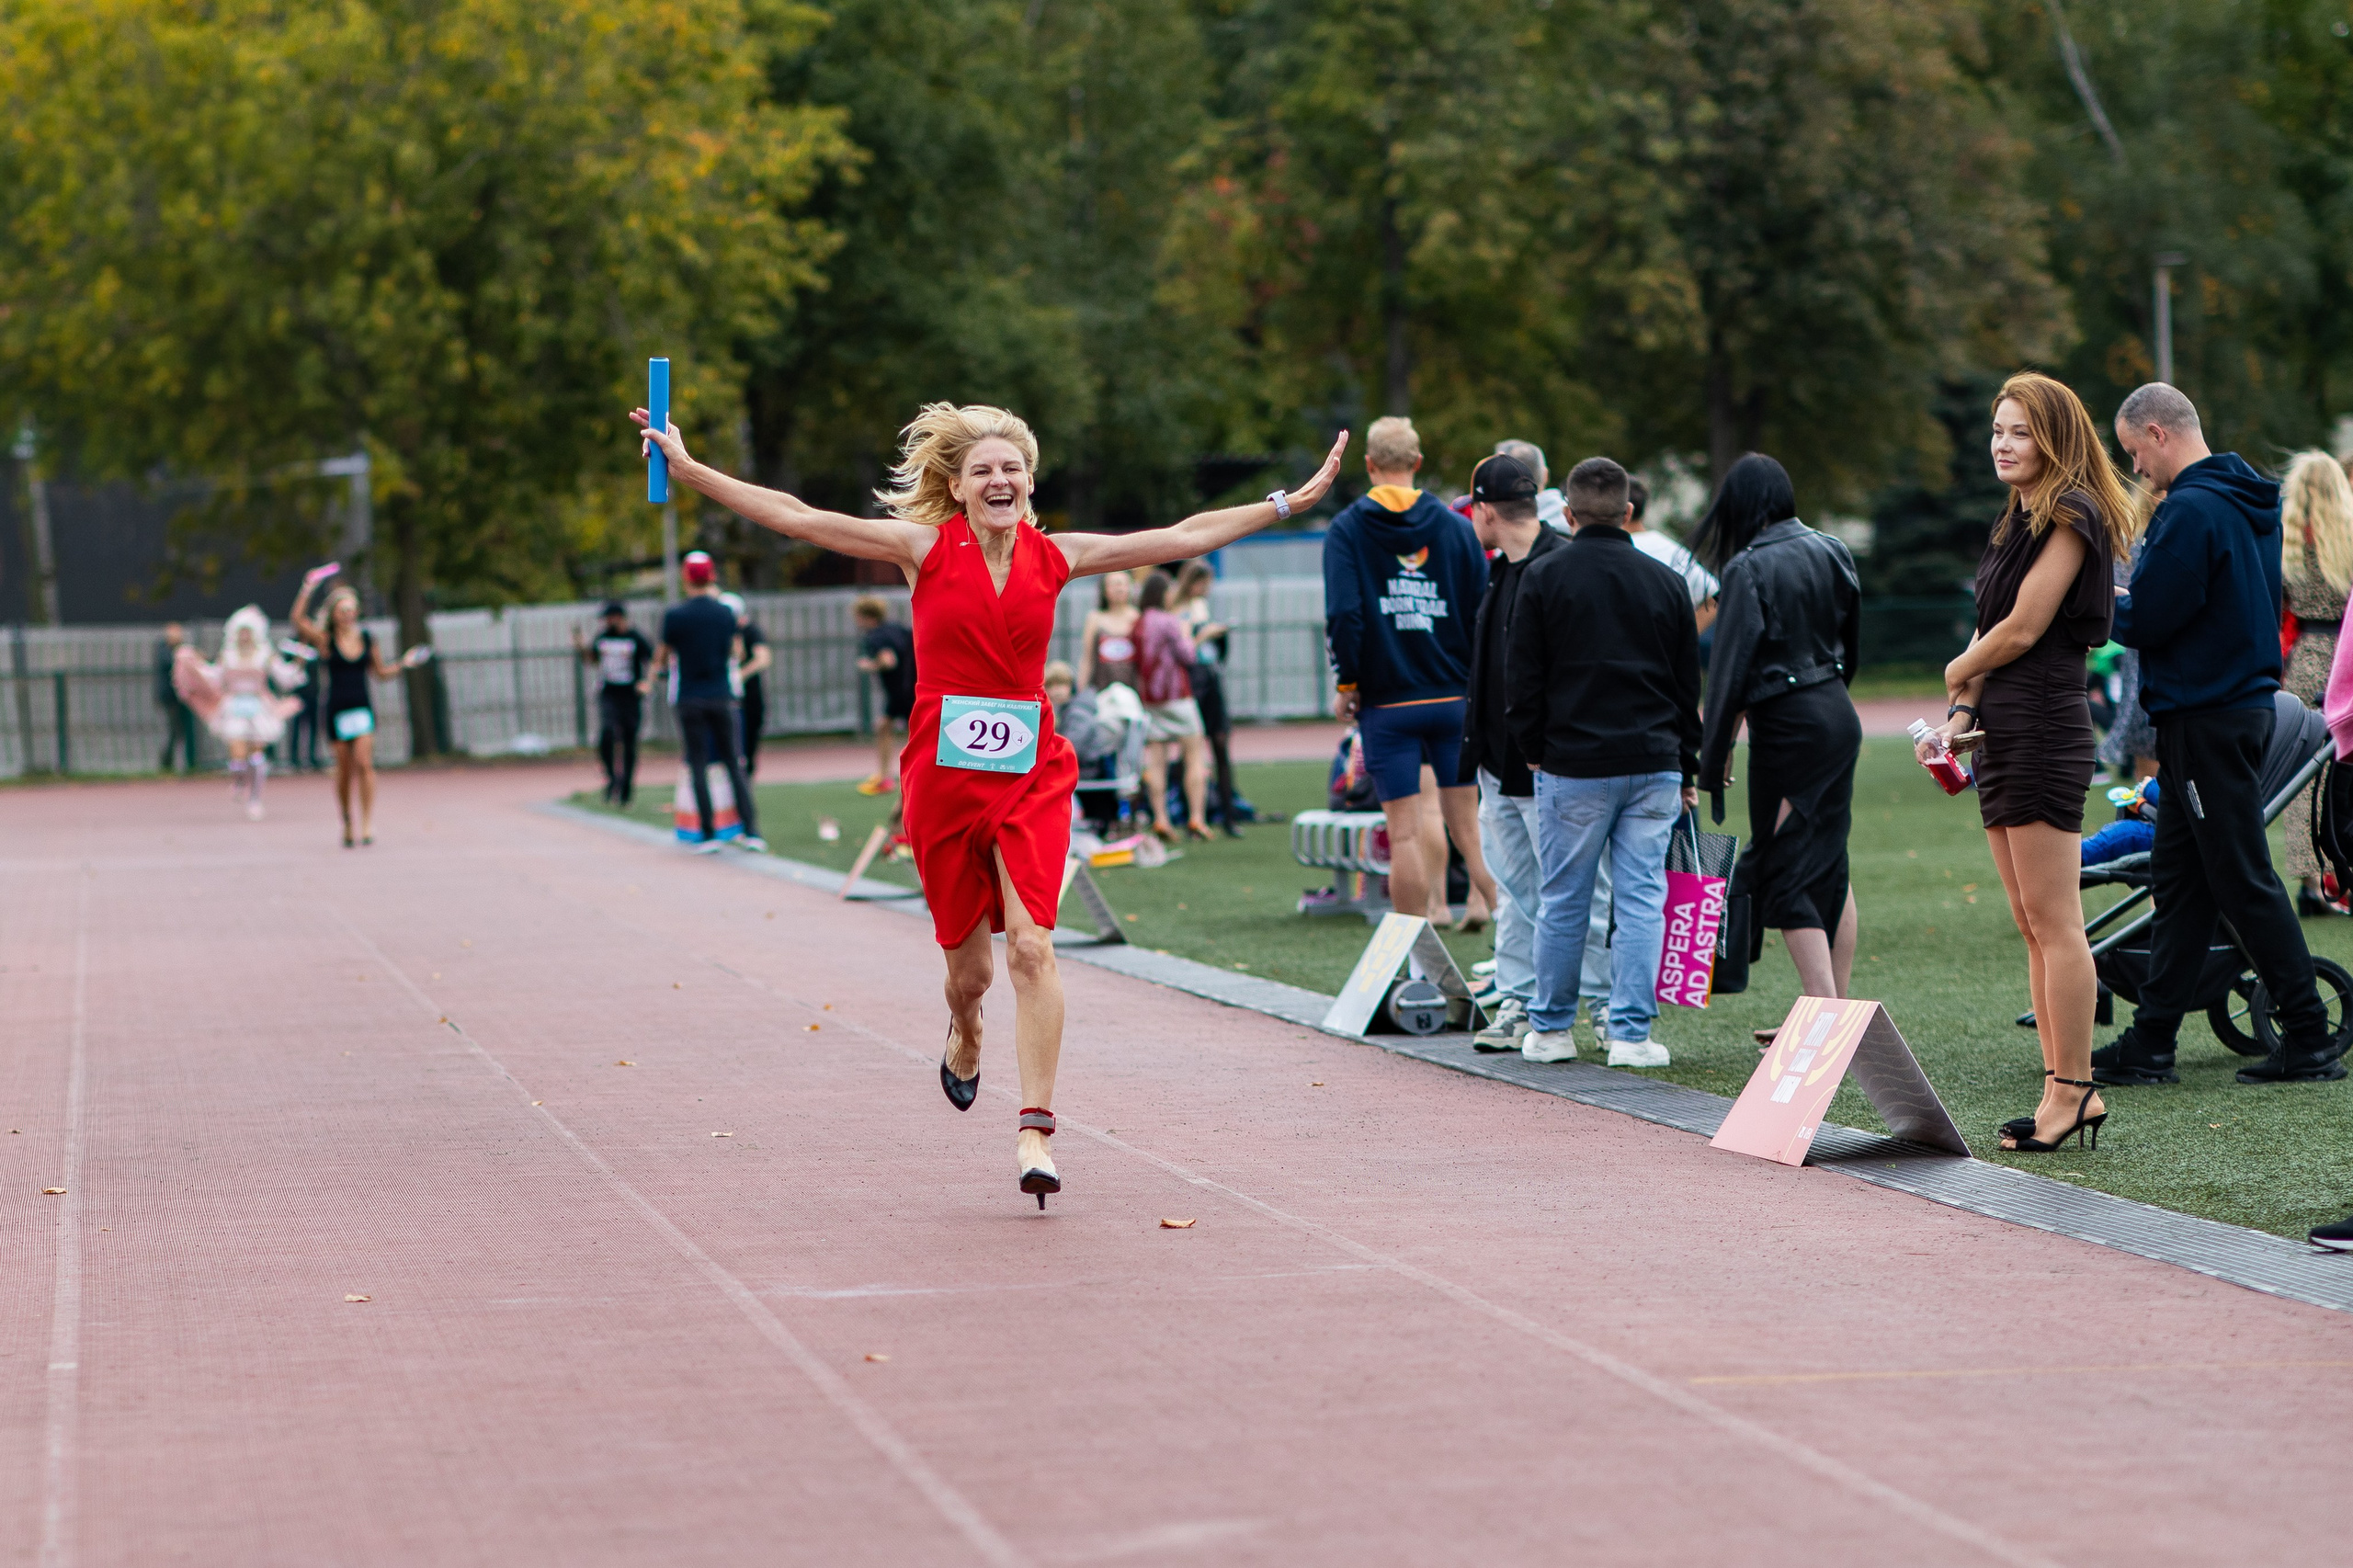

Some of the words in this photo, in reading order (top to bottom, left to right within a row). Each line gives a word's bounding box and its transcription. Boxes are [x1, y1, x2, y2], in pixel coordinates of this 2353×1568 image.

[966, 720, 1010, 752] 29
[1659, 902, 1696, 1005] ASPERA
[1693, 881, 1726, 967] ASTRA
[1686, 970, 1710, 1009] AD
